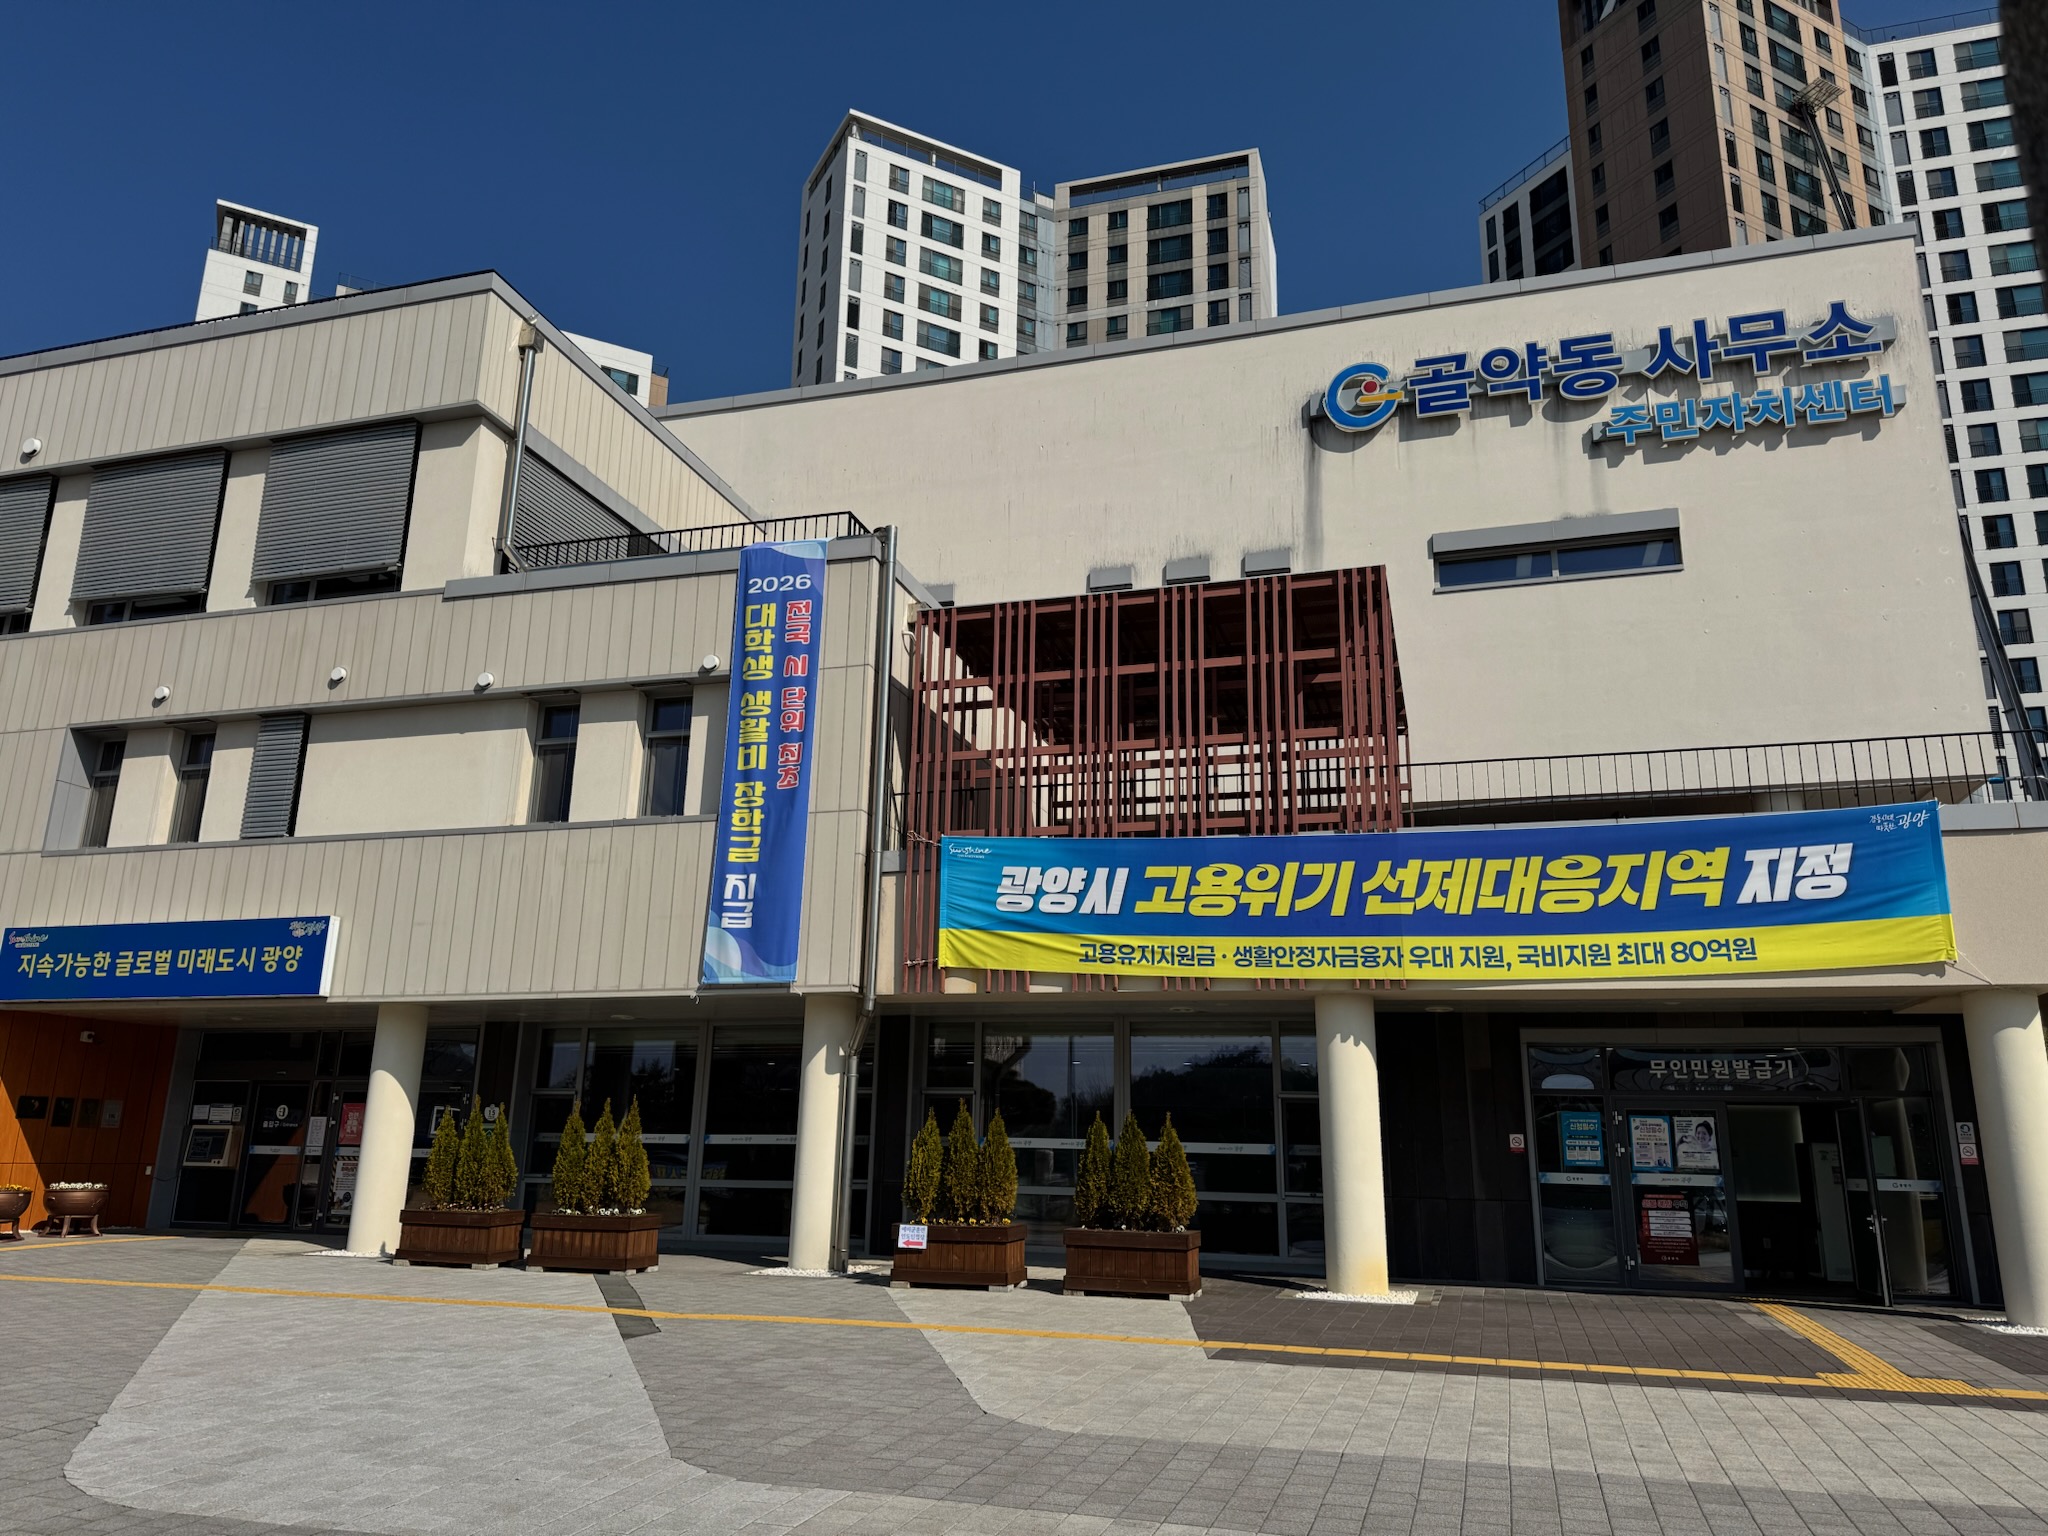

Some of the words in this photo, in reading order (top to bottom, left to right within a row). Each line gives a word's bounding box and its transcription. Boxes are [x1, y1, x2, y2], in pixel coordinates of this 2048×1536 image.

[1406, 331, 1625, 418] 골약동
[1641, 300, 1884, 382] 사무소
[1606, 372, 1897, 446] 주민자치센터
[747, 573, 812, 594] 2026
[741, 602, 777, 681] 대학생
[784, 599, 813, 644] 전국
[783, 653, 809, 678] 시
[736, 690, 773, 770] 생활비
[780, 686, 807, 733] 단위
[776, 742, 803, 789] 최초
[727, 780, 767, 863] 장학금
[1896, 809, 1931, 829] 광양
[948, 843, 992, 855] Sunshine
[720, 873, 758, 929] 지급
[995, 865, 1130, 916] 광양시
[1134, 861, 1356, 918] 고용위기
[1362, 846, 1731, 916] 선제대응지역
[1736, 842, 1854, 905] 지정
[17, 952, 112, 979] 지속가능한
[114, 949, 171, 976] 글로벌
[176, 946, 257, 975] 미래도시
[260, 944, 304, 973] 광양
[1078, 943, 1216, 967] 고용유지지원금
[1233, 944, 1404, 970] 생활안정자금융자
[1409, 945, 1453, 969] 우대
[1460, 945, 1512, 971] 지원,
[1517, 943, 1612, 968] 국비지원
[1617, 941, 1666, 966] 최대
[1670, 937, 1758, 963] 80억원
[1649, 1059, 1794, 1080] 무인민원발급기
